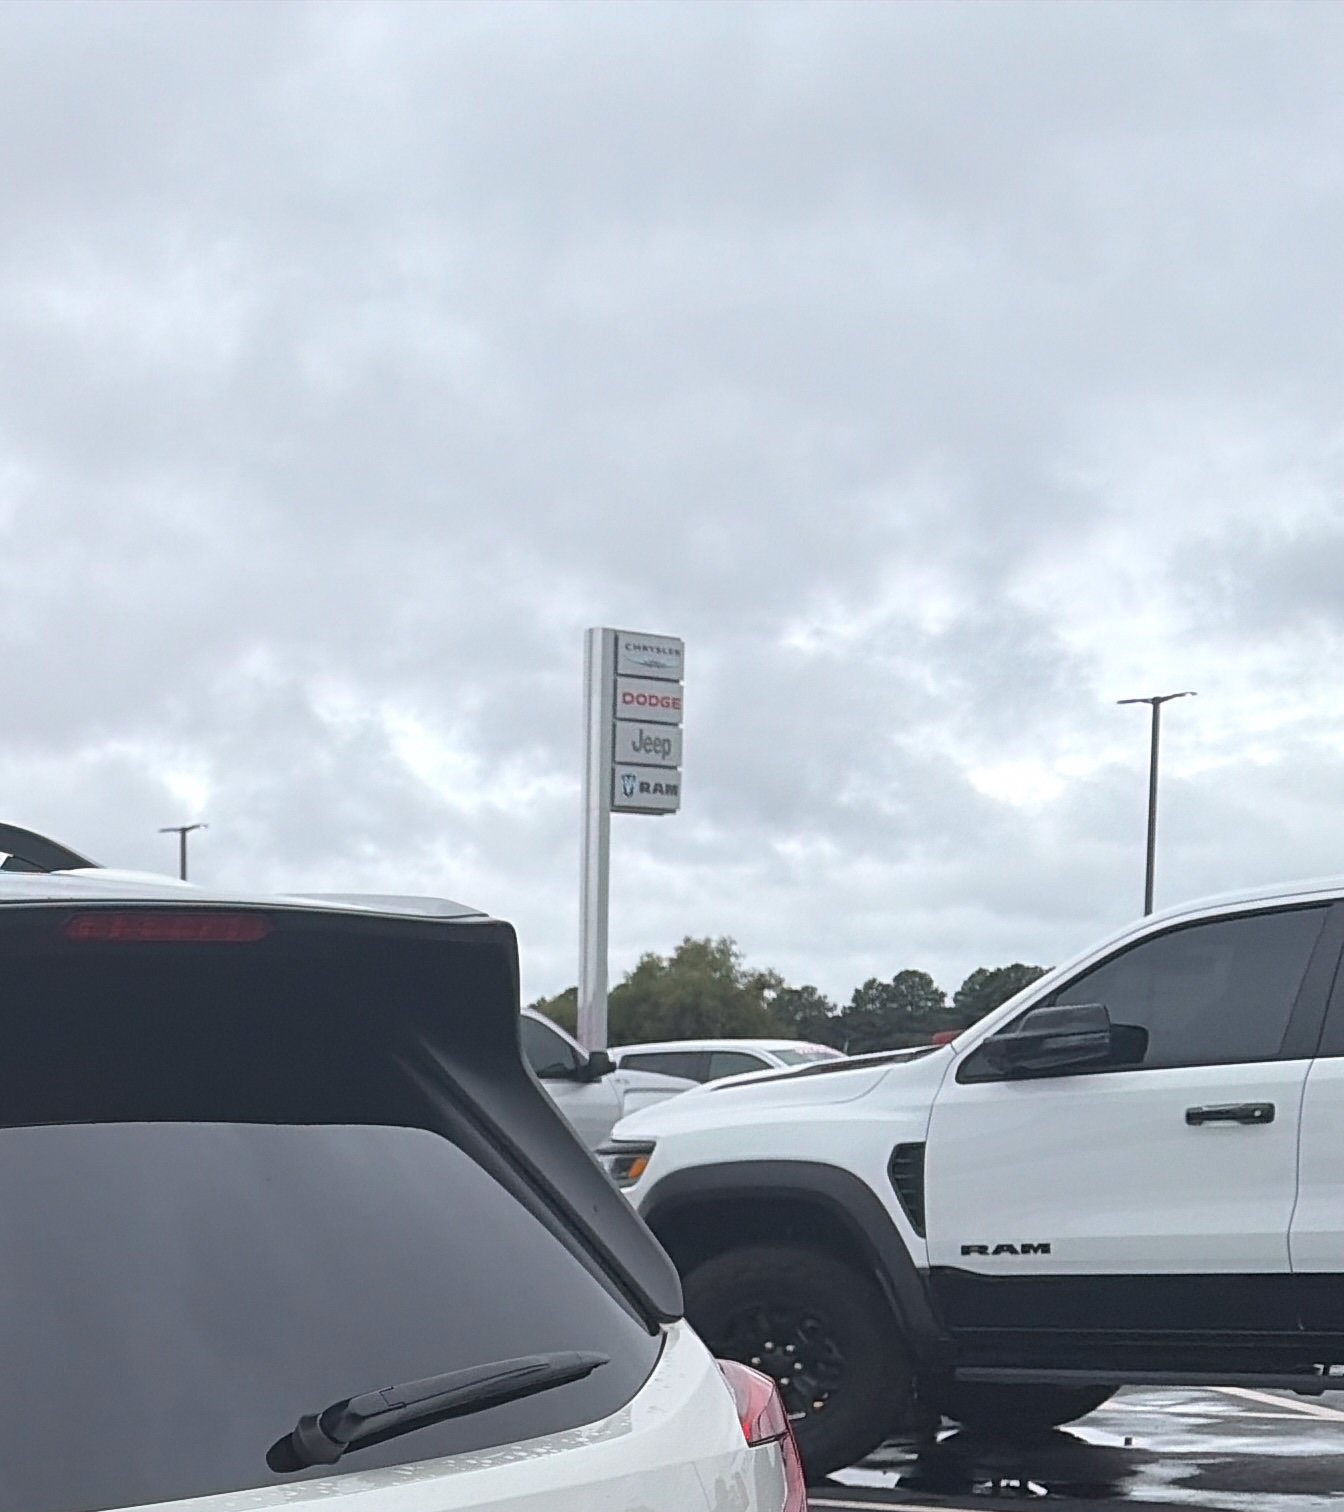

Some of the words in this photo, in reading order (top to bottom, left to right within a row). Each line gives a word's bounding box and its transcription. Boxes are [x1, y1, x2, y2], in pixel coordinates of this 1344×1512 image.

[625, 642, 681, 655] CHRYSLER
[622, 692, 681, 710] DODGE
[632, 729, 671, 760] Jeep
[639, 782, 678, 796] RAM
[961, 1243, 1051, 1256] RAM
